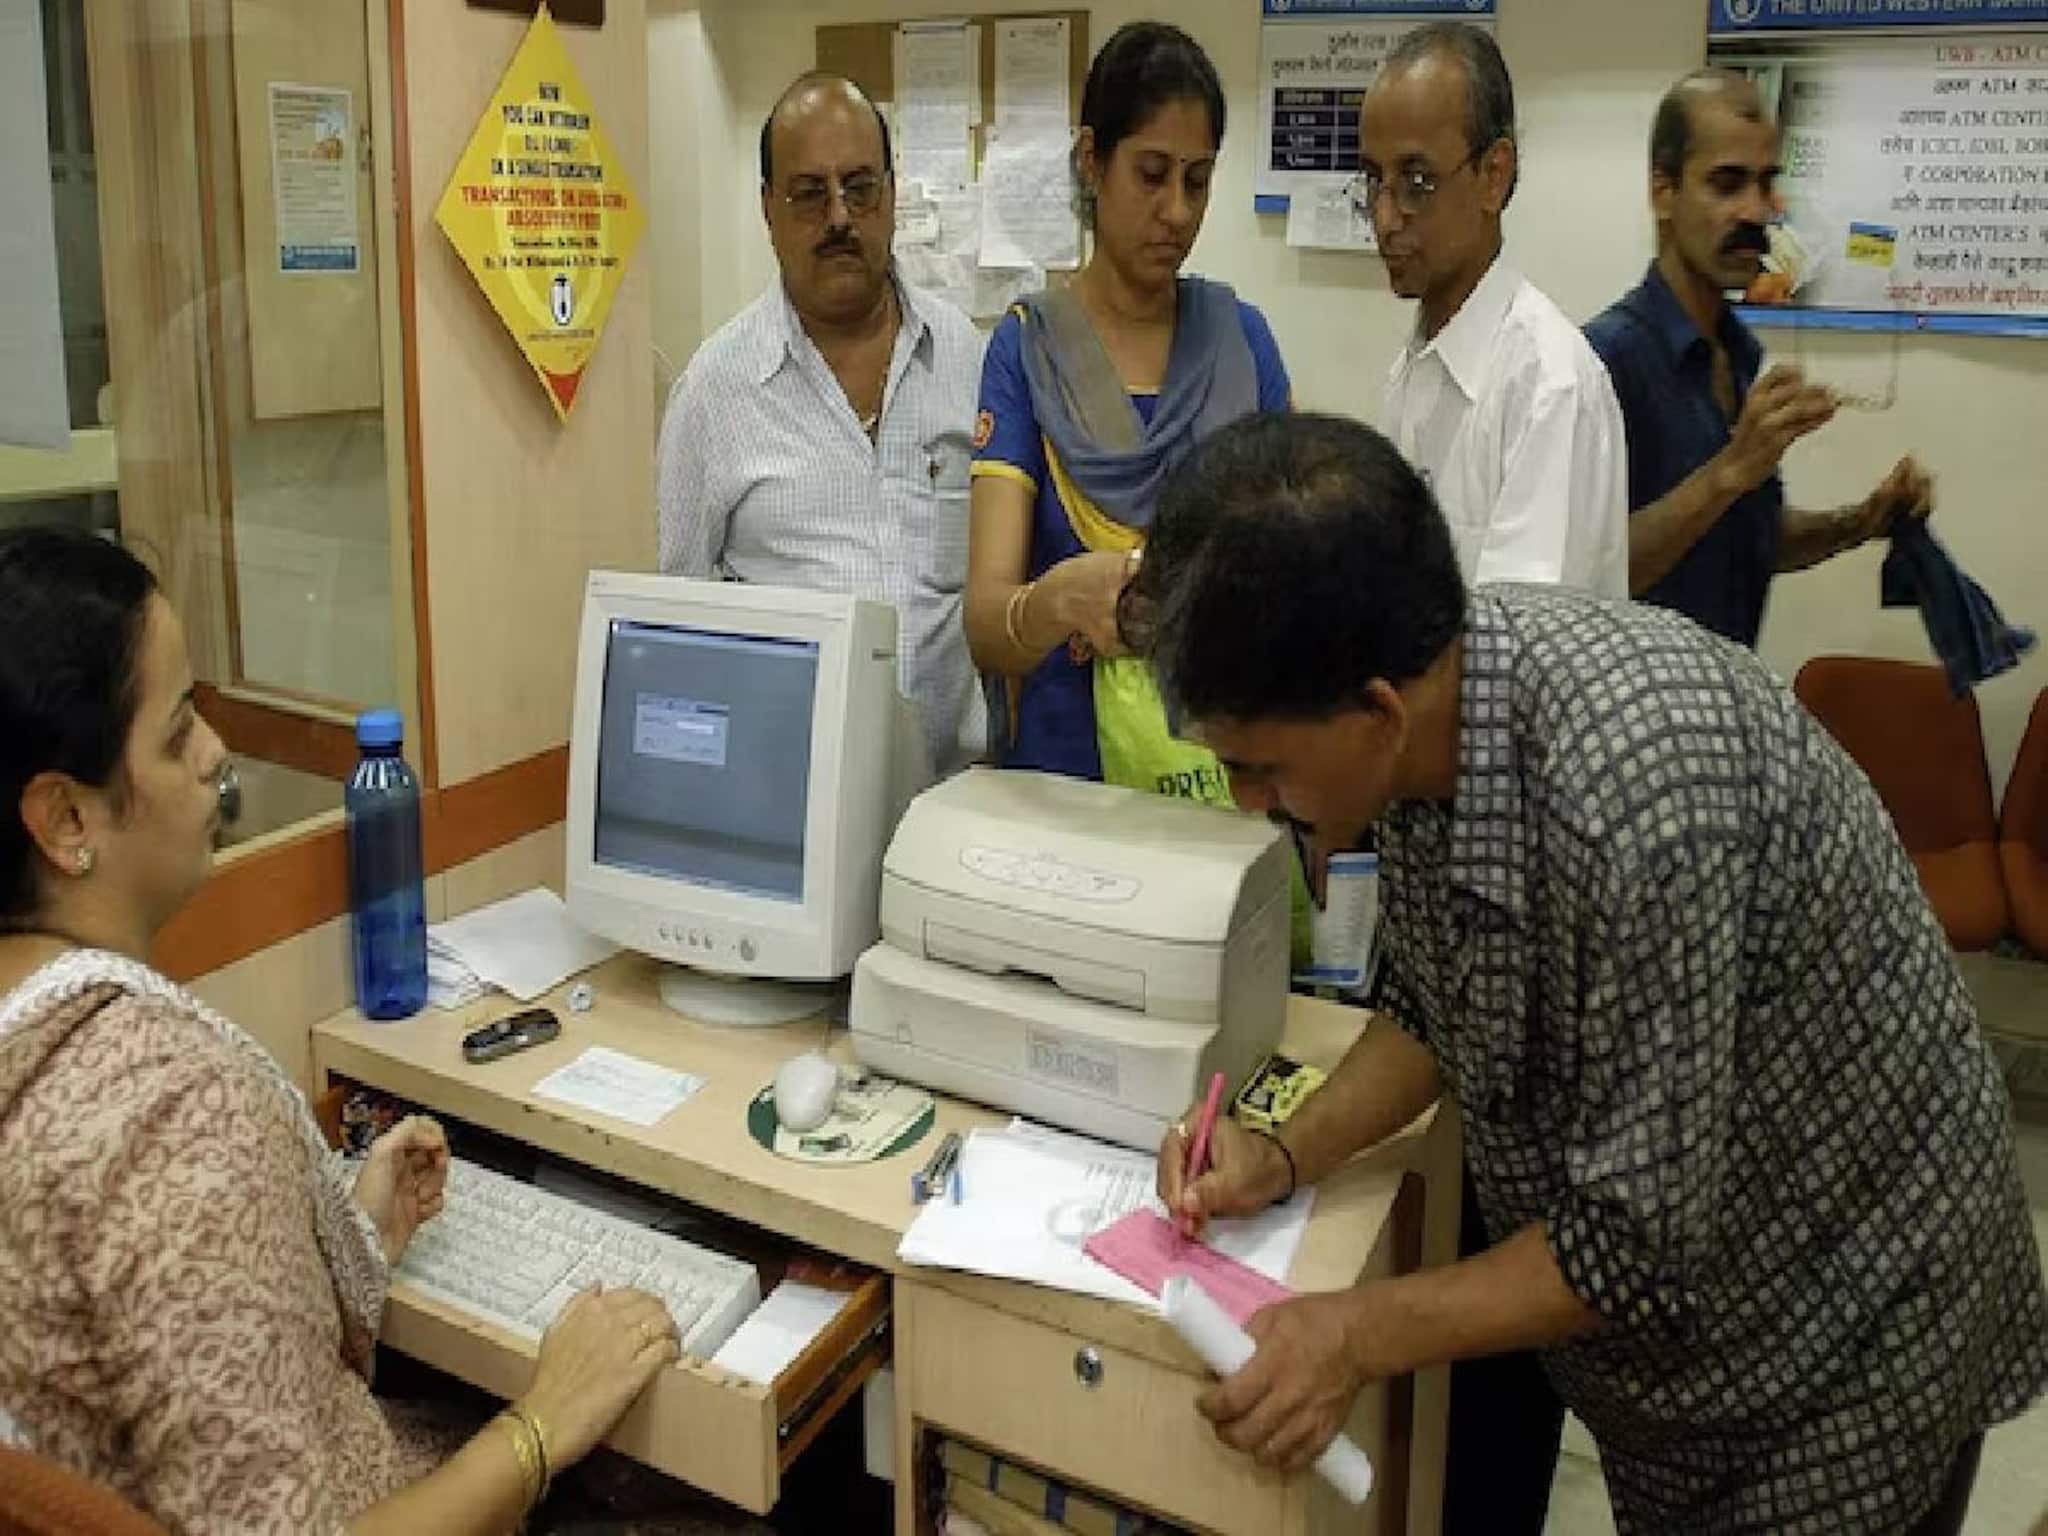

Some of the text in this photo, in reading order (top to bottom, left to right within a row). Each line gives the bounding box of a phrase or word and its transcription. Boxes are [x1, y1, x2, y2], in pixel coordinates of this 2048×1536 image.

[1980, 79, 2016, 95] ATM
[1949, 110, 1987, 127] ATM
[1908, 224, 1945, 242] ATM
